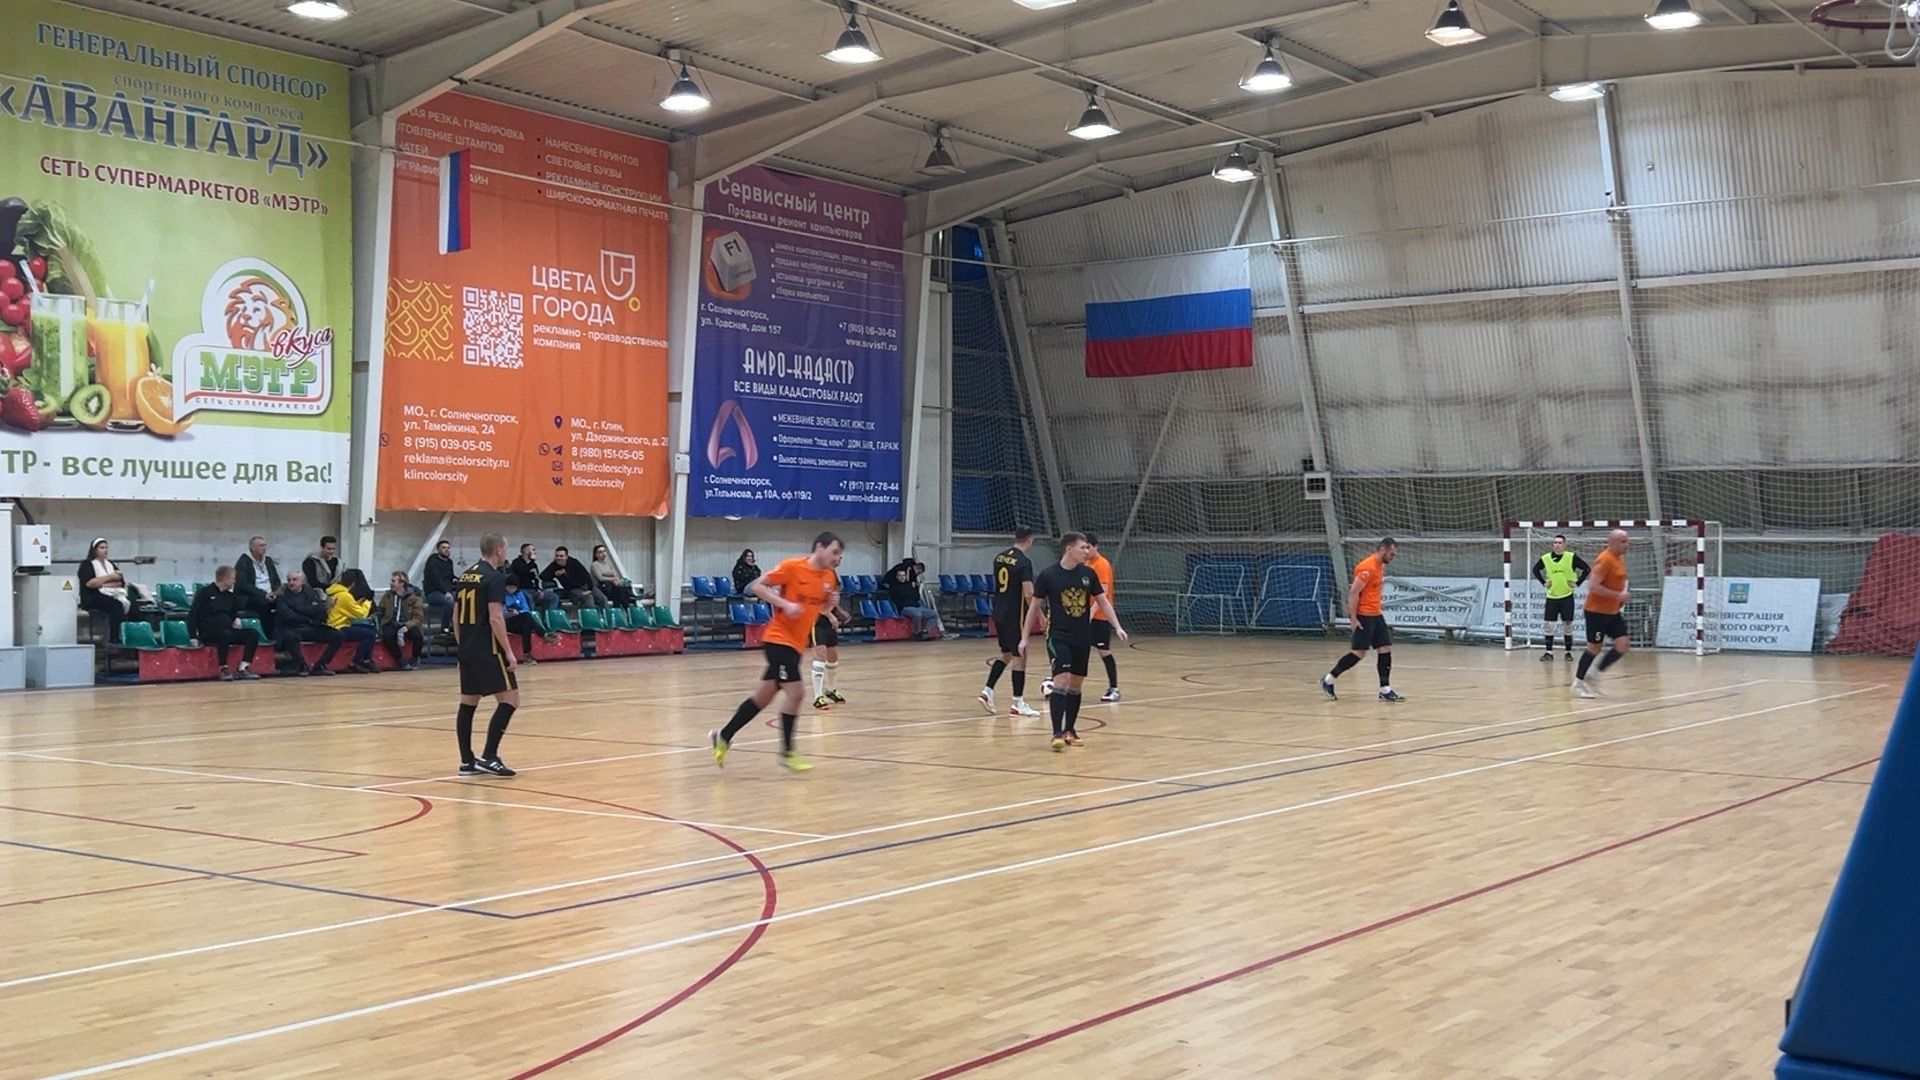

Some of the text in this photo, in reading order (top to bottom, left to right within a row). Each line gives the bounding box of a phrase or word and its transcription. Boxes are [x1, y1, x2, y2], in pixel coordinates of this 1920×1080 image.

[36, 22, 328, 101] ГЕНЕРАЛЬНЫЙ СПОНСОР
[114, 73, 305, 121] спортивного комплекса
[463, 118, 525, 141] ГРАВИРОВКА
[455, 135, 505, 154] ШТАМПОВ
[545, 137, 640, 167] НАНЕСЕНИЕ ПРИНТОВ
[545, 154, 622, 179] СВЕТОВЫЕ БУКВЫ
[40, 155, 329, 216] СЕТЬ СУПЕРМАРКЕТОВ «МЭТР»
[546, 189, 638, 214] ШИРОКОФОРМАТНАЯ
[718, 176, 870, 229] Сервисный центр
[728, 203, 863, 239] Продажа и ремонт компьютеров
[724, 239, 742, 256] F1
[532, 265, 597, 294] ЦВЕТА
[532, 294, 616, 327] ГОРОДА
[533, 324, 581, 338] рекламно
[700, 316, 713, 327] ул.
[751, 324, 767, 333] дом
[769, 325, 782, 334] 157
[533, 337, 581, 351] компания
[200, 351, 318, 396] МЭТР
[742, 348, 855, 386] АМРО-КАДАСТР
[734, 380, 863, 404] ВСЕ ВИДЫ КАДАСТРОВЫХ РАБОТ
[195, 397, 322, 412] СЕТЬ СУПЕРМАРКЕТОВ
[403, 420, 420, 432] ул.
[481, 424, 496, 435] 2А
[571, 432, 584, 443] ул.
[404, 437, 493, 452] 8 (915) 039-05-05
[571, 446, 645, 461] 8 (980) 151-05-05
[61, 455, 113, 477] все
[120, 457, 227, 485] лучшее
[233, 461, 278, 484] для
[286, 459, 333, 483] Вас!
[404, 469, 469, 484] klincolorscity
[571, 476, 625, 490] klincolorscity
[998, 566, 1009, 593] 9
[457, 587, 477, 625] 11
[1690, 611, 1784, 621] АМИНИСТРАЦИЯ
[1595, 631, 1603, 641] 5
[1750, 623, 1790, 632] ОКРУГА
